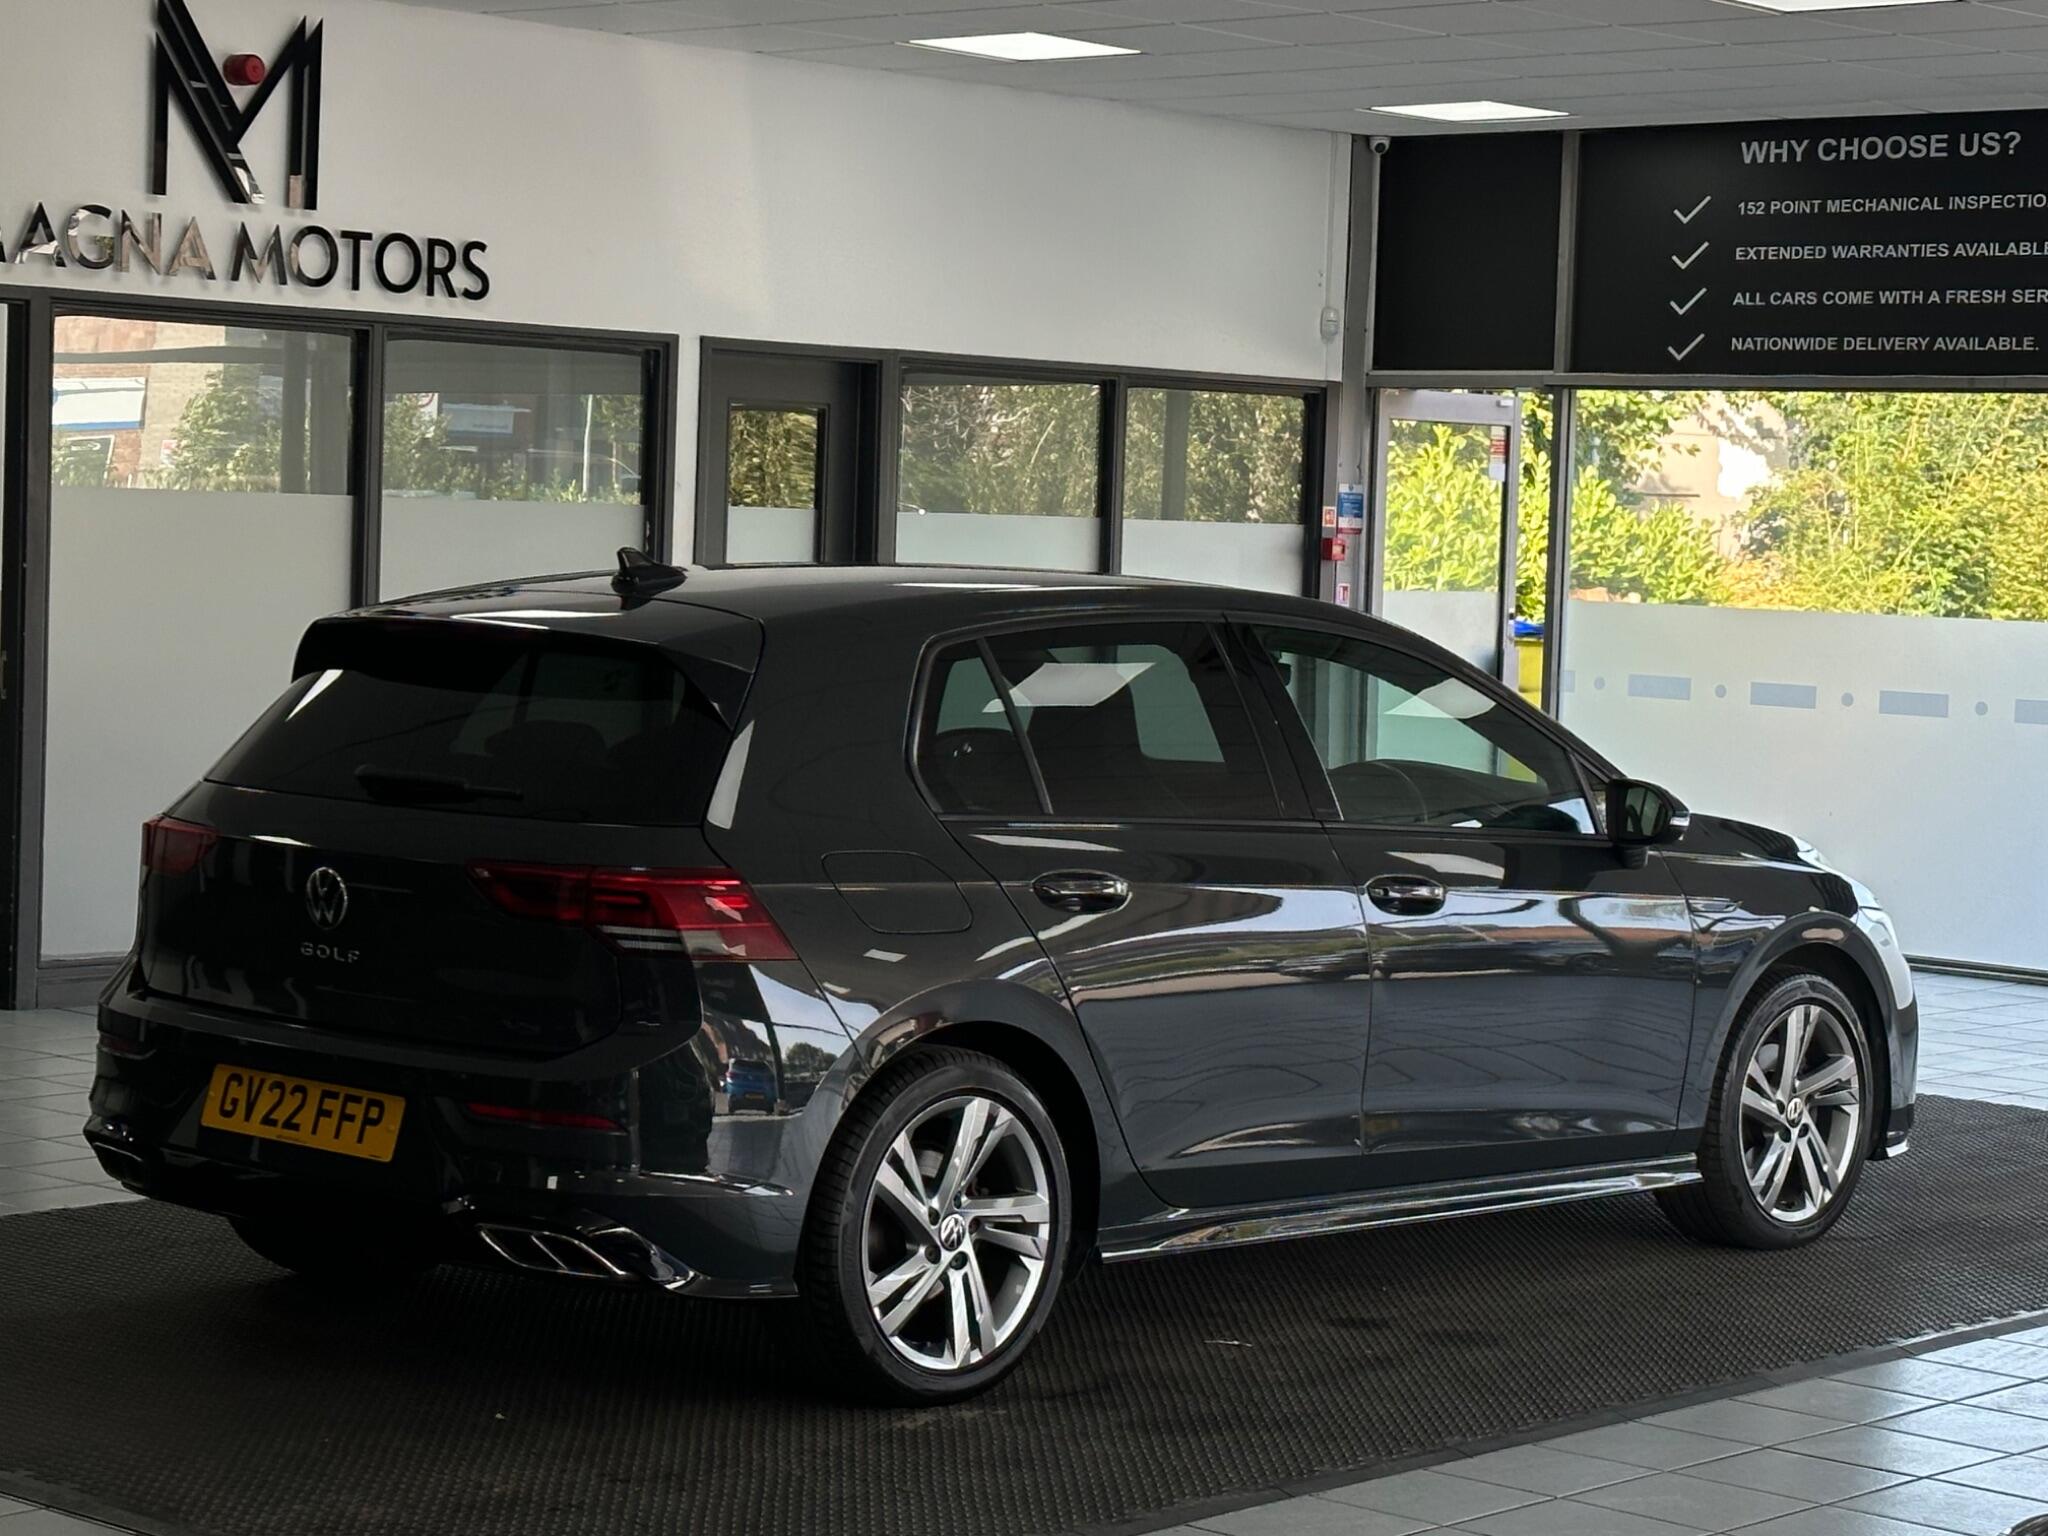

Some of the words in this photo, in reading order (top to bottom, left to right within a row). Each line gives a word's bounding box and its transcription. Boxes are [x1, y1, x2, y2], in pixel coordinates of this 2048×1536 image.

[1740, 139, 1811, 164] WHY
[1817, 134, 1949, 161] CHOOSE
[1959, 131, 2022, 157] US?
[1737, 201, 1765, 216] 152
[1770, 200, 1822, 214] POINT
[1826, 196, 1944, 213] MECHANICAL
[0, 201, 216, 281] AGNA
[229, 221, 490, 300] MOTORS
[1735, 246, 1827, 260] EXTENDED
[1831, 243, 1950, 259] WARRANTIES
[1732, 292, 1766, 306] ALL
[1769, 291, 1818, 305] CARS
[1822, 291, 1874, 305] COME
[1879, 290, 1924, 304] WITH
[1927, 290, 1941, 304] A
[1945, 290, 2006, 304] FRESH
[1731, 337, 1838, 351] NATIONWIDE
[1843, 337, 1930, 351] DELIVERY
[1933, 337, 2039, 351] AVAILABLE.
[300, 942, 361, 963] GOLF
